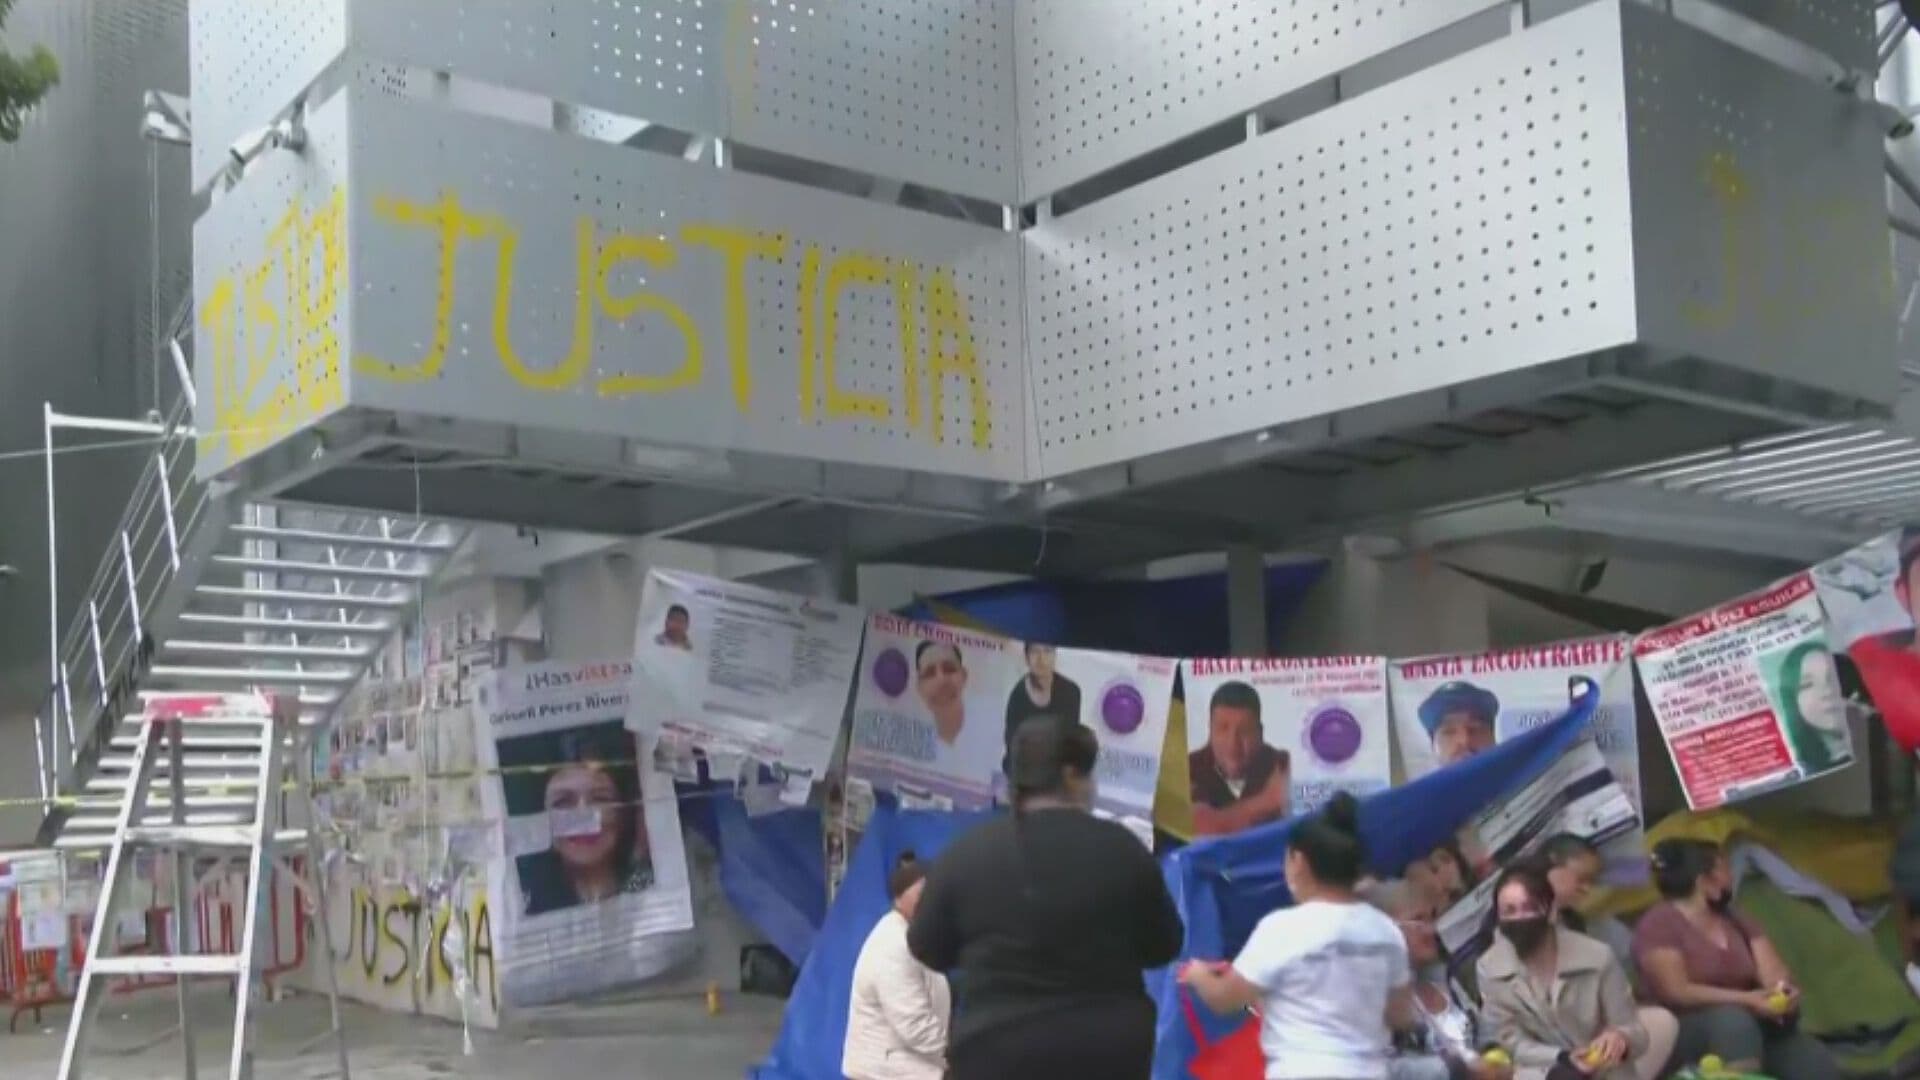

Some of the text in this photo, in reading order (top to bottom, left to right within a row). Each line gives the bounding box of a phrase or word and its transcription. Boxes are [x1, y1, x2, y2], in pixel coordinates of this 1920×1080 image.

[353, 190, 994, 450] JUSTICIA
[1402, 655, 1463, 680] HASTA
[1471, 639, 1625, 673] ENCONTRARTE
